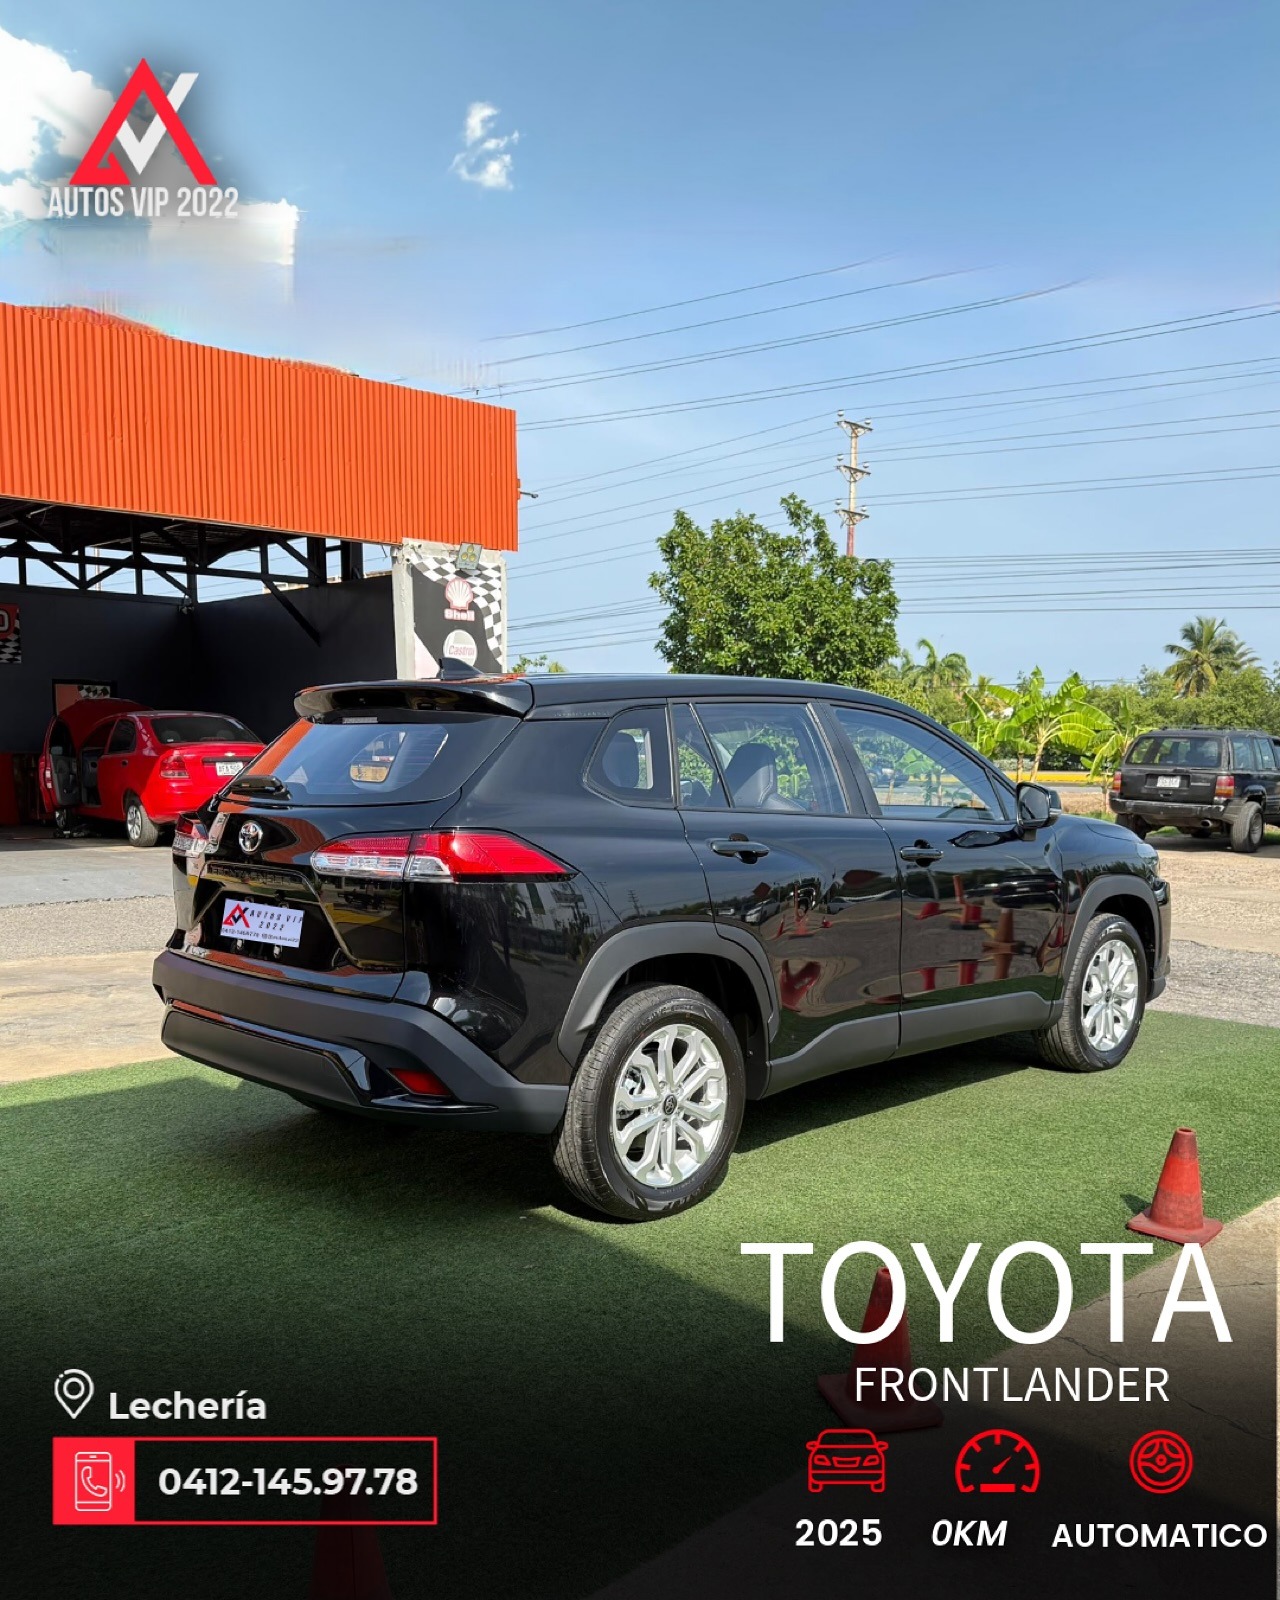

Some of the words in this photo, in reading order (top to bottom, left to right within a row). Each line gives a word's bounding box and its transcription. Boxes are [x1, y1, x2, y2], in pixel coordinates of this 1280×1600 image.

[444, 608, 475, 622] Shell
[249, 909, 282, 921] AUTOS
[258, 920, 285, 932] 2022
